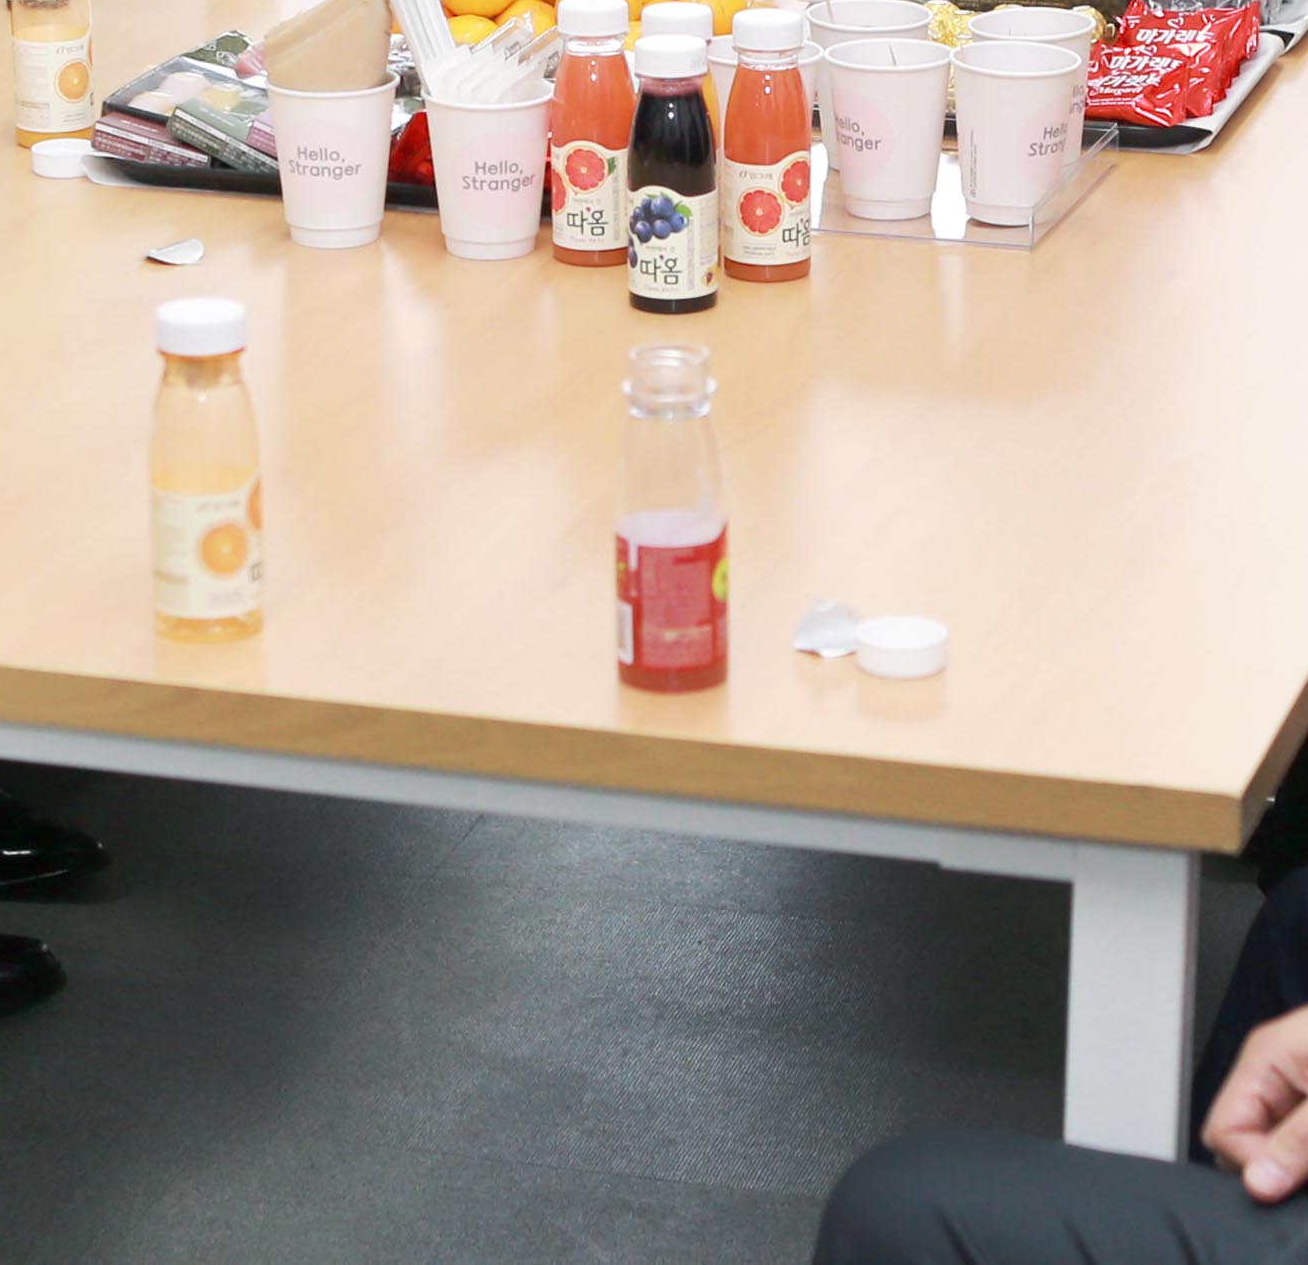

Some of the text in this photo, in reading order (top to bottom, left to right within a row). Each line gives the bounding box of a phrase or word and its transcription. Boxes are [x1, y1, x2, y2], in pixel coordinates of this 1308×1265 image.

[297, 146, 345, 163] Hello,
[289, 160, 361, 180] Stranger
[474, 160, 523, 176] Hello,
[462, 174, 535, 192] Stranger
[567, 208, 609, 236] 따옴
[640, 257, 683, 285] 따옴
